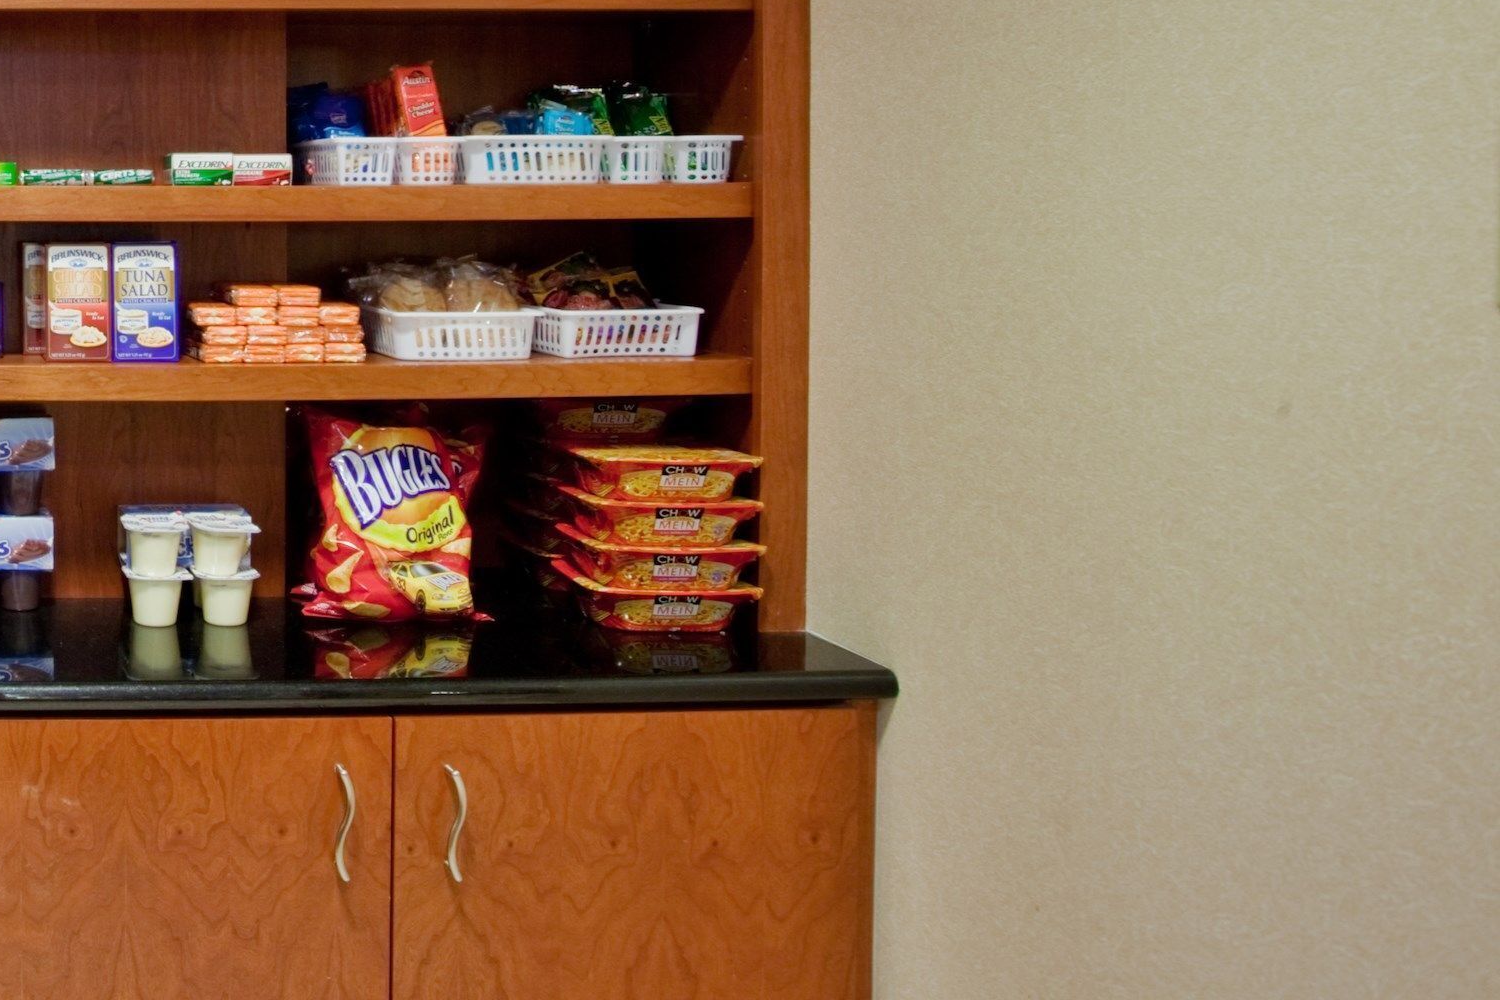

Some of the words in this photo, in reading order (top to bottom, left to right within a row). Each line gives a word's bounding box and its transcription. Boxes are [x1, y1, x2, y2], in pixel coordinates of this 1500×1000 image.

[403, 76, 430, 86] Austin
[178, 160, 228, 168] EXCEDRIN
[238, 160, 286, 168] EXCEDRIN
[51, 250, 104, 263] BRUNSWICK
[117, 250, 170, 263] BRUNSWICK
[53, 270, 103, 284] CHICKEN
[123, 270, 165, 282] TUNA
[54, 284, 102, 296] SALAD
[121, 284, 168, 296] SALAD
[331, 446, 450, 525] BUGLES
[664, 478, 700, 486] MEIN
[406, 505, 454, 544] Original
[658, 520, 696, 530] MEIN
[657, 567, 694, 576] MEIN
[657, 606, 694, 615] MEIN
